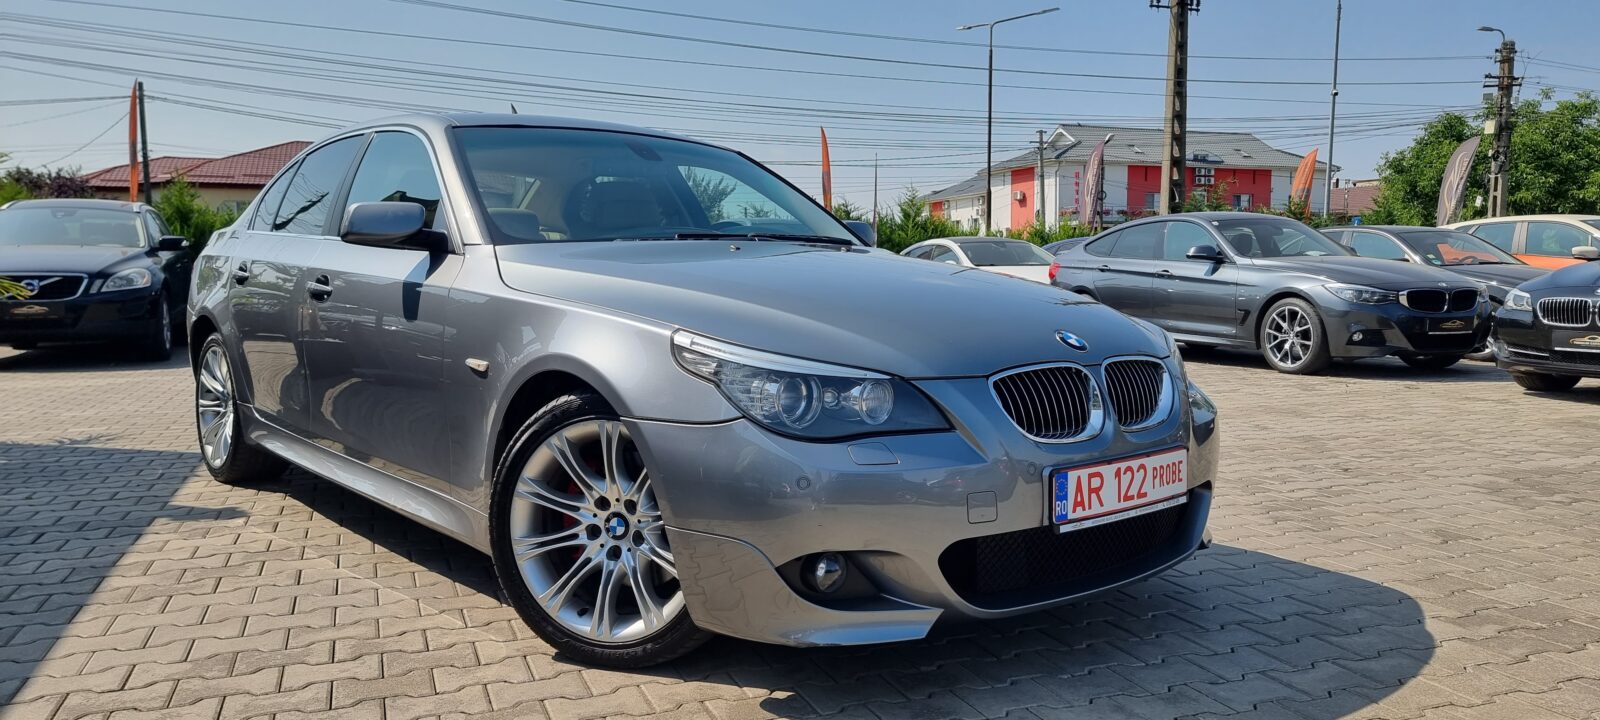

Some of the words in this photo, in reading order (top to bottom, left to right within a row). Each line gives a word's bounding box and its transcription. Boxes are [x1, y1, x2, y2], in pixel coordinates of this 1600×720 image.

[1072, 471, 1104, 513] AR
[1114, 463, 1148, 503] 122
[1152, 460, 1183, 489] PROBE
[1056, 500, 1067, 516] RO
